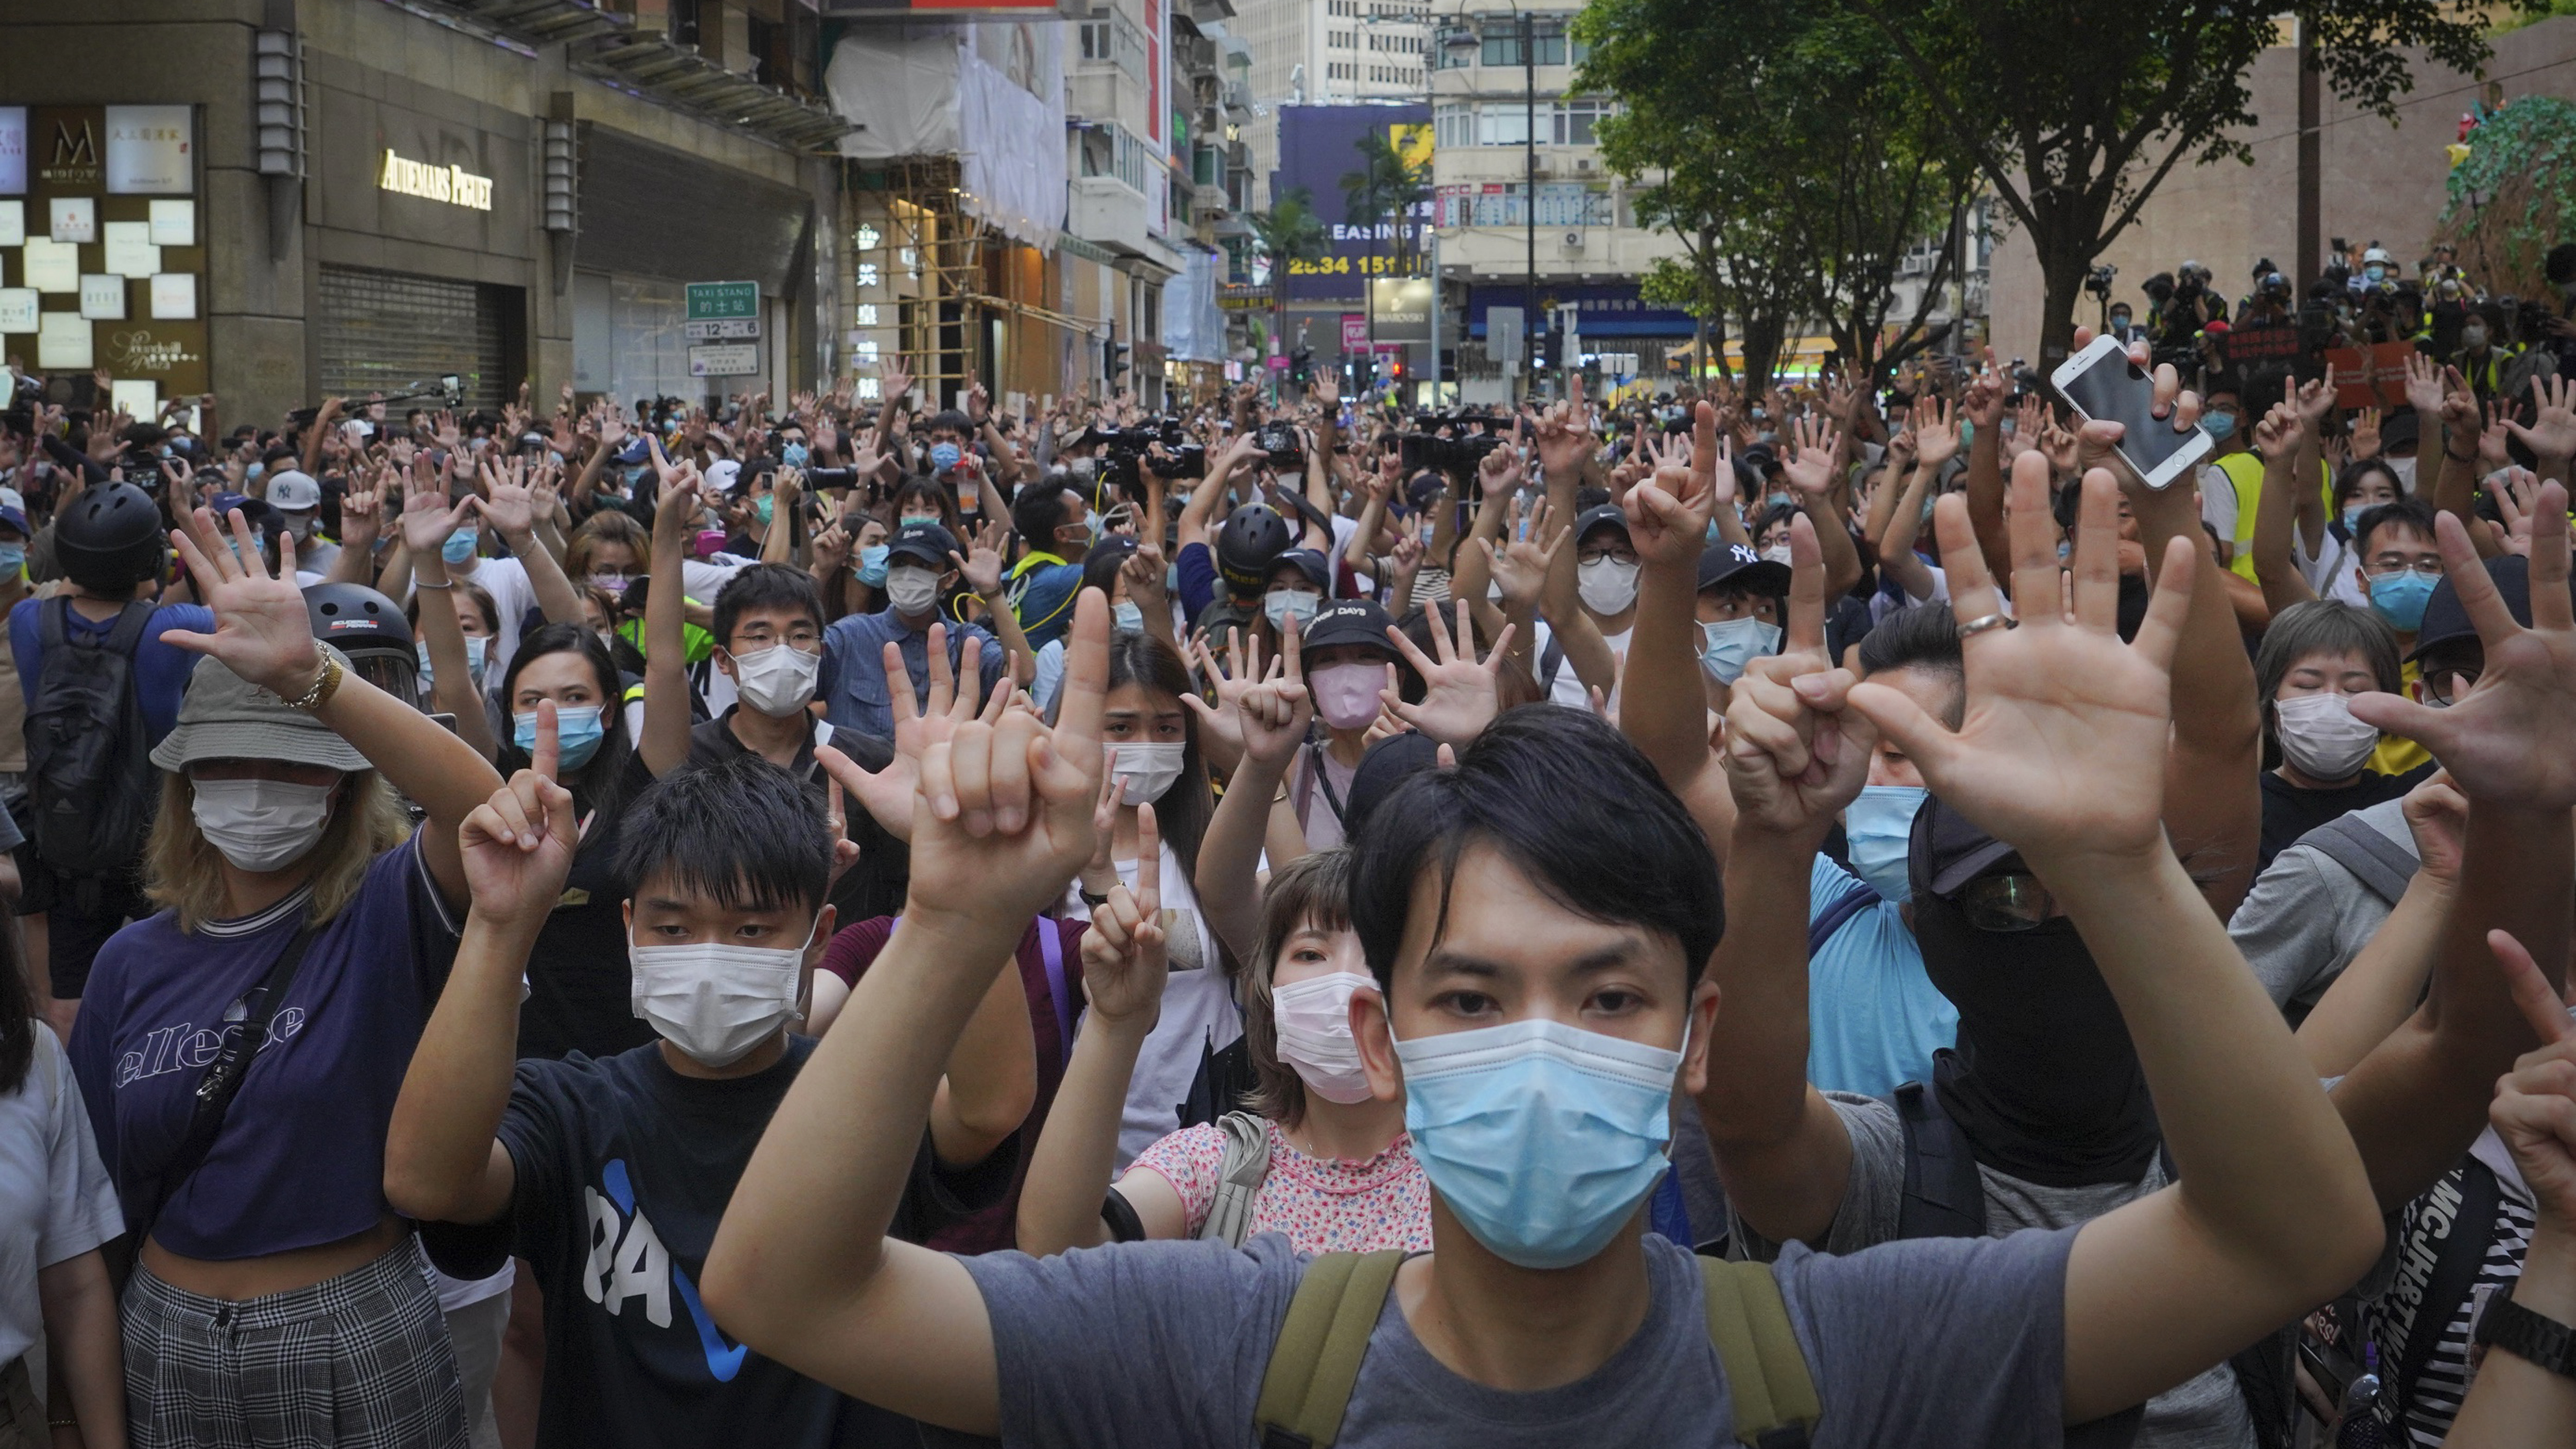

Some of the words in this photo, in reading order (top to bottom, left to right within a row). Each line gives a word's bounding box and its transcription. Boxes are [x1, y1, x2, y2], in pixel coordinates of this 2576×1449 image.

[381, 148, 450, 203] AUDEMARS
[450, 164, 493, 211] PIGUET
[1321, 224, 1413, 240] EASING
[1358, 256, 1412, 274] 151
[693, 289, 714, 297] TAXI
[717, 288, 751, 297] STAND
[700, 299, 745, 313] 的士站
[748, 322, 756, 334] 6
[1730, 544, 1758, 563] NY
[1338, 607, 1366, 617] DAYS
[116, 1007, 306, 1089] ellese
